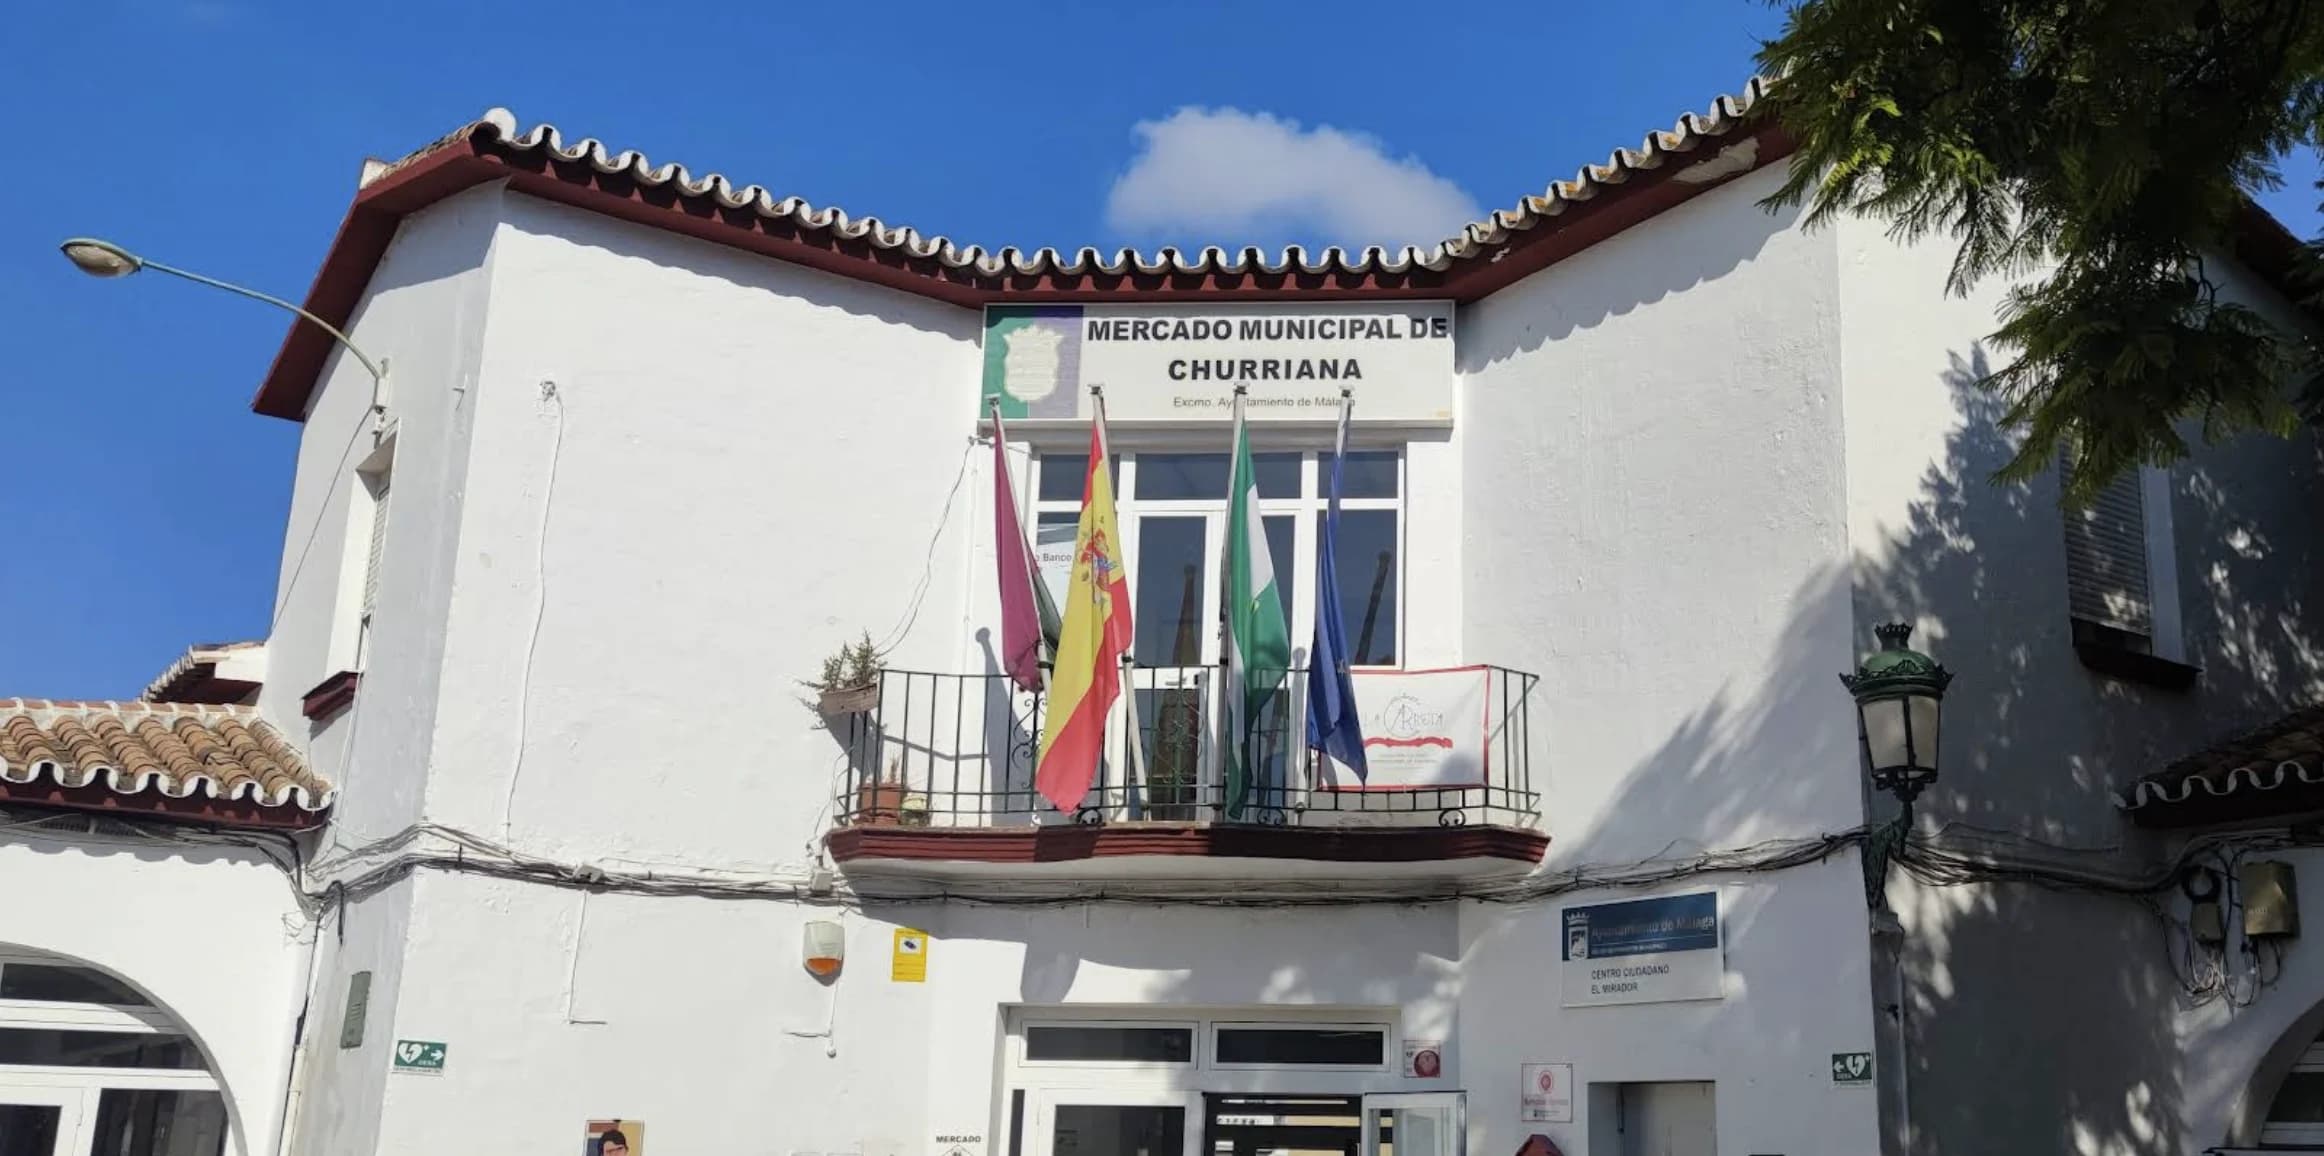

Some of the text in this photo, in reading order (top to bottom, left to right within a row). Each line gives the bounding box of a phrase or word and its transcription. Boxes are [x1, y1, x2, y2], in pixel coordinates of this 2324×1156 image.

[1088, 318, 1448, 340] MERCADO MUNICIPAL DE
[1168, 359, 1363, 380] CHURRIANA
[1218, 397, 1293, 410] Aytamiento
[1298, 396, 1311, 407] de
[1661, 919, 1674, 931] de
[1592, 964, 1669, 980] CENTRO CIUDADANO
[1592, 982, 1638, 994] EL MIRADOR
[935, 1135, 981, 1143] MERCADO
